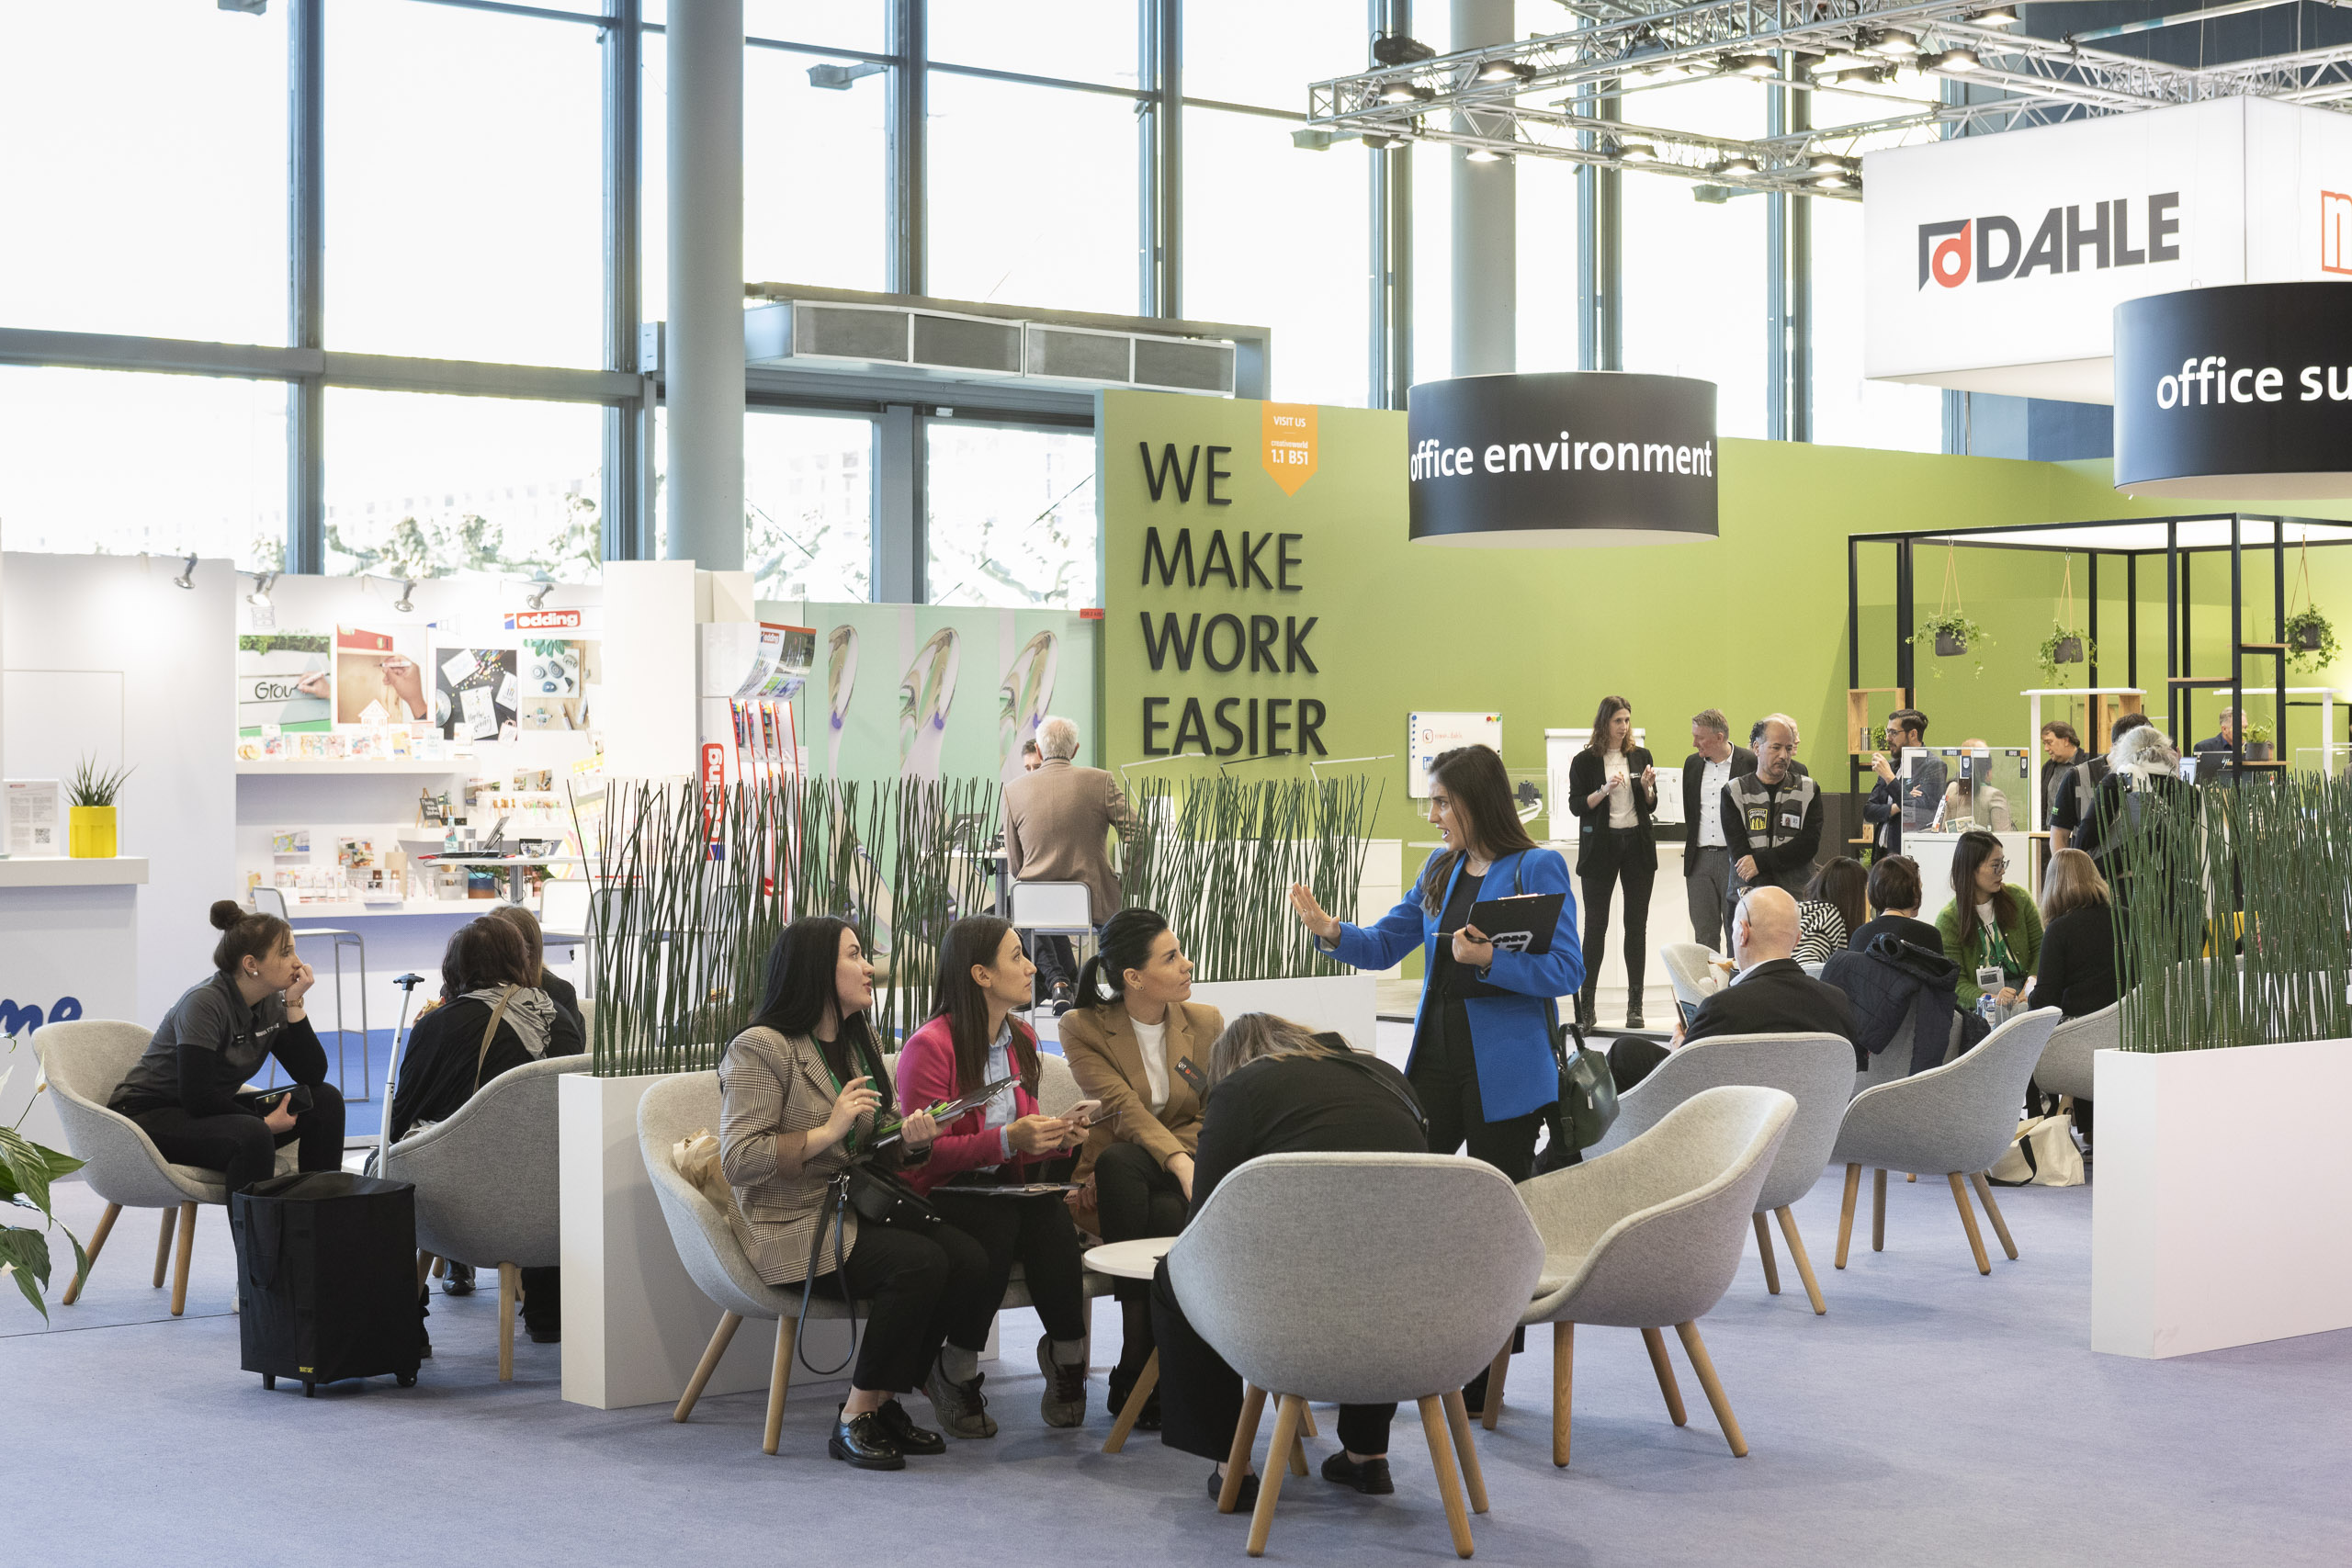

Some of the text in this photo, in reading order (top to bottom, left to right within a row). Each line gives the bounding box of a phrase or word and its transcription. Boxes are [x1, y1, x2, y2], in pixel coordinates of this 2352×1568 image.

[1976, 191, 2179, 283] DAHLE
[2156, 356, 2352, 410] office su
[1273, 416, 1306, 427] VISIT US
[1139, 442, 1232, 504] WE
[1272, 449, 1308, 466] 1.1 B51
[1410, 431, 1712, 481] office environment
[1142, 526, 1303, 591] MAKE
[518, 613, 578, 627] edding
[1140, 611, 1319, 673] WORK
[1143, 697, 1329, 756] EASIER
[705, 748, 723, 839] edding
